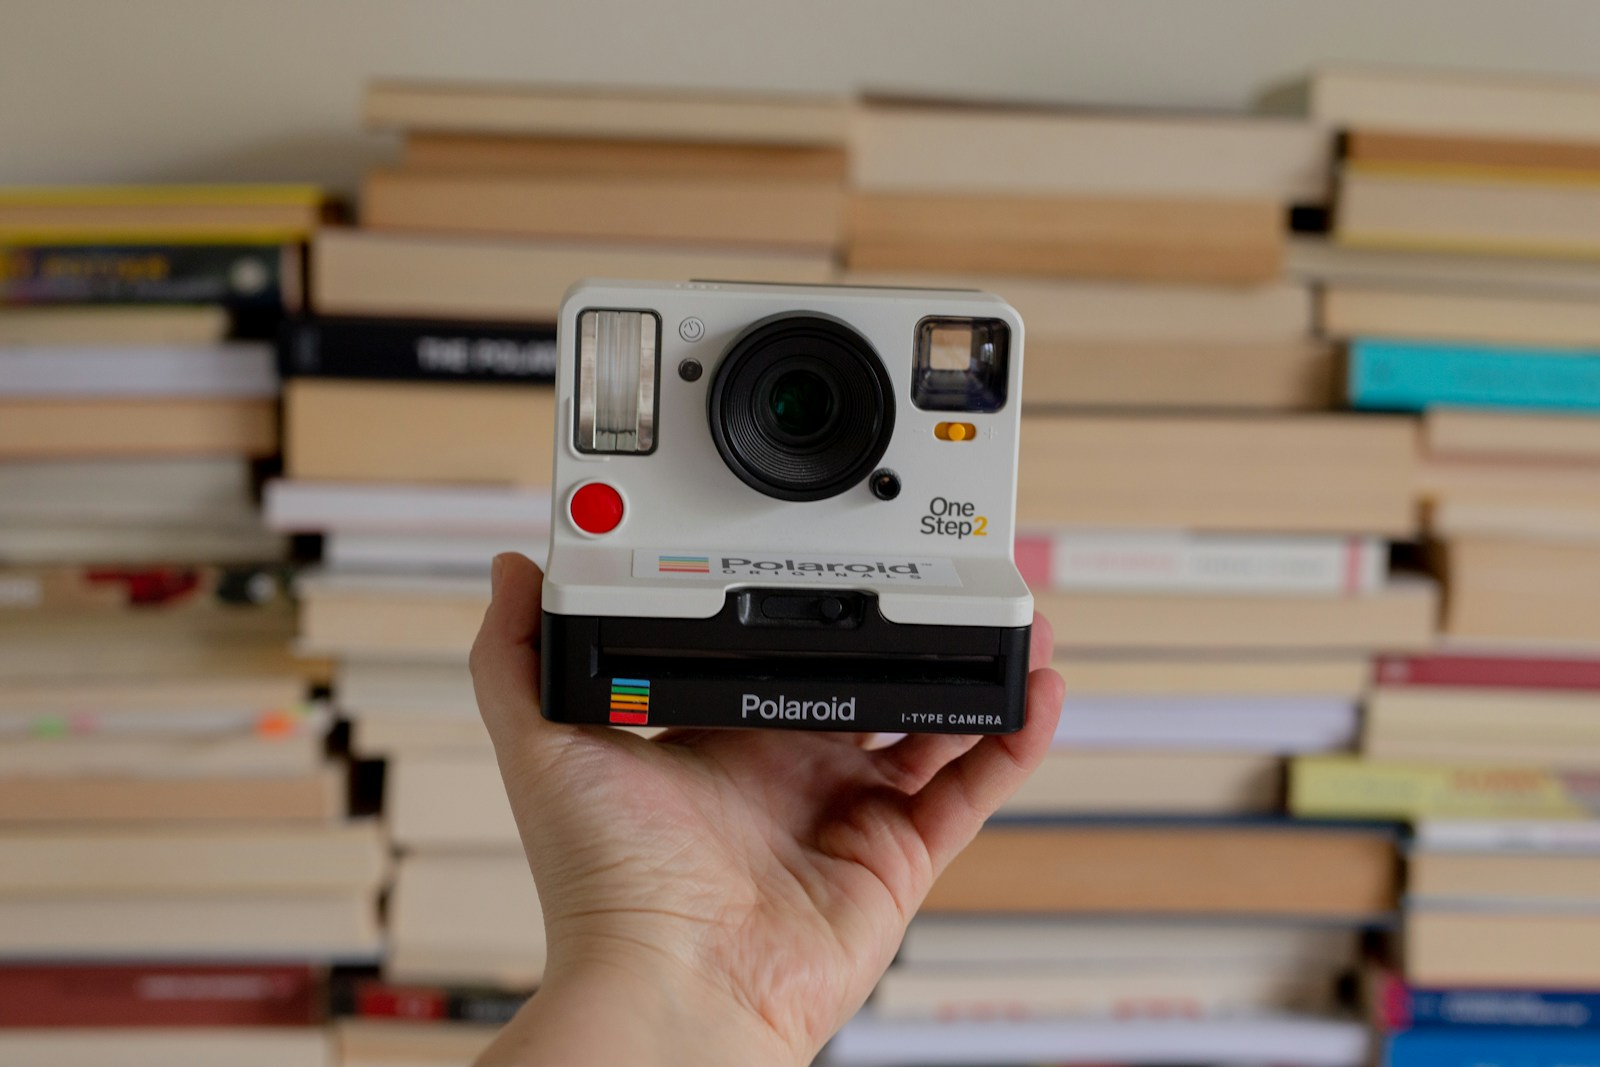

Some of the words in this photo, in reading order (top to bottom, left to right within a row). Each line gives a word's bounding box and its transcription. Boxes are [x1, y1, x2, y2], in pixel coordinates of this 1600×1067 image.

[929, 496, 975, 517] One
[920, 515, 988, 540] Step2
[721, 557, 919, 574] Polaroid
[722, 569, 922, 580] ORIGINALS
[741, 694, 856, 721] Polaroid
[901, 713, 944, 724] I-TYPE
[948, 714, 1002, 725] CAMERA
